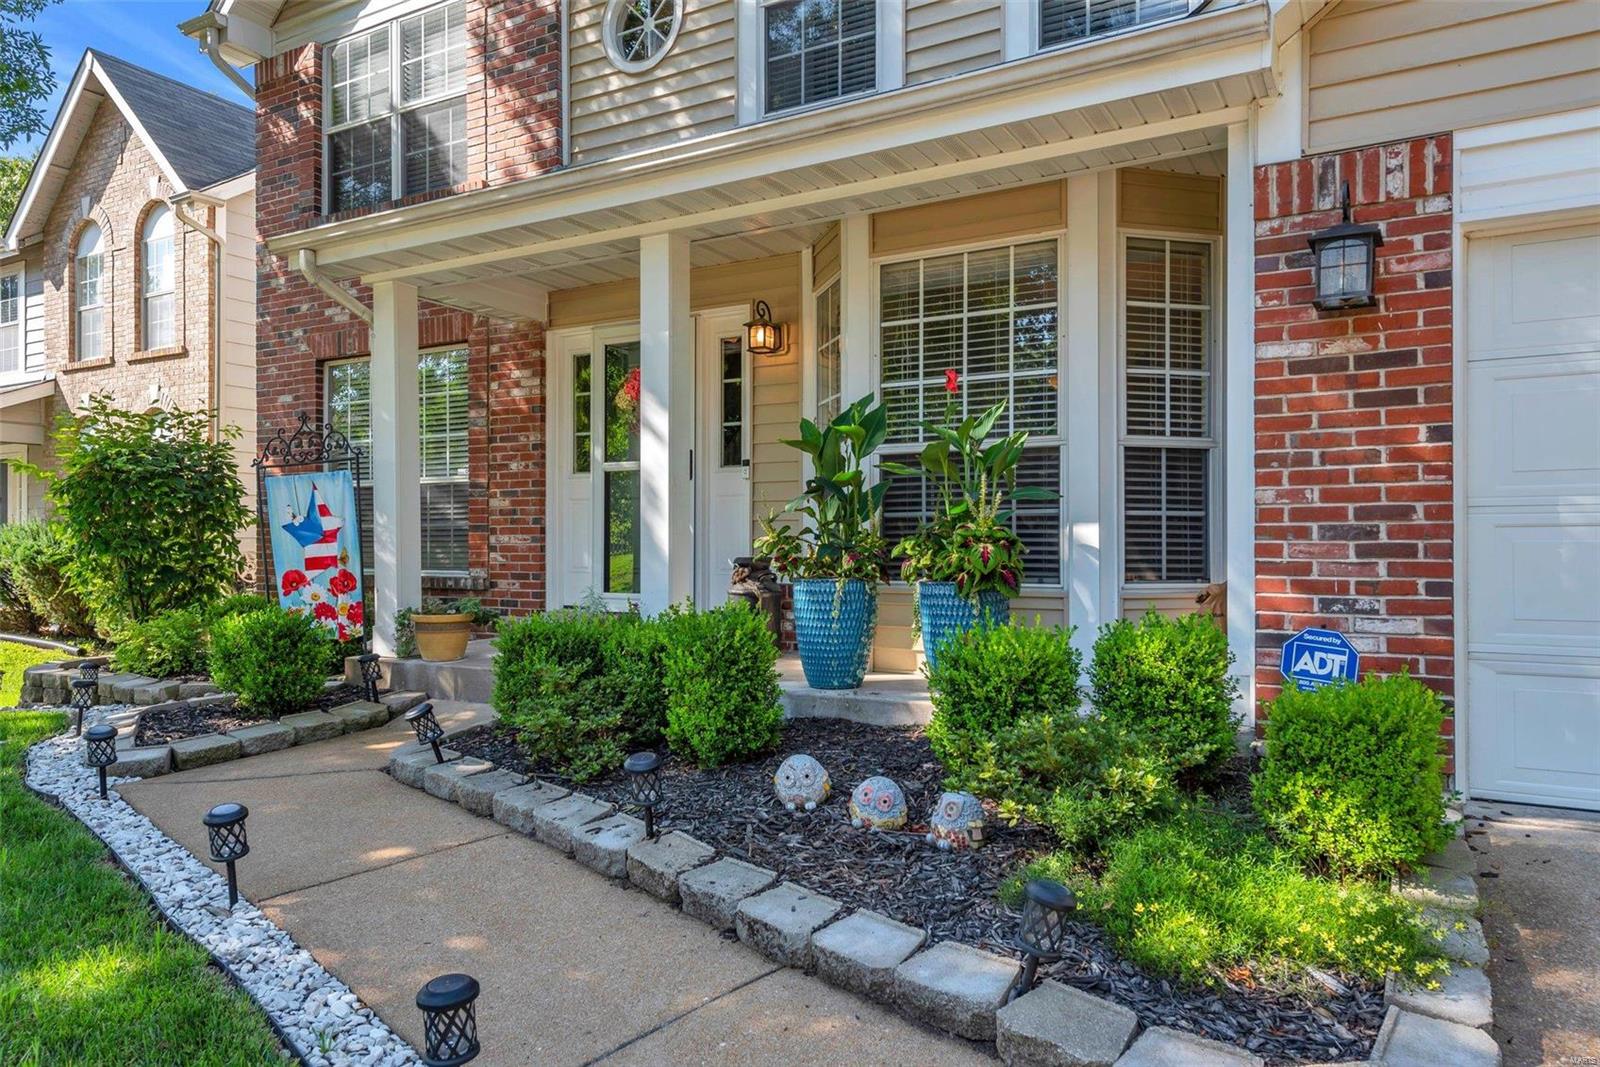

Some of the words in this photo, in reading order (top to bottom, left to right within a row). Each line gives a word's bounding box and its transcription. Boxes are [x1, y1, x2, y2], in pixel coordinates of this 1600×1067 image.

[1303, 633, 1332, 643] Secured
[1332, 637, 1341, 645] by
[1293, 650, 1346, 677] ADT
